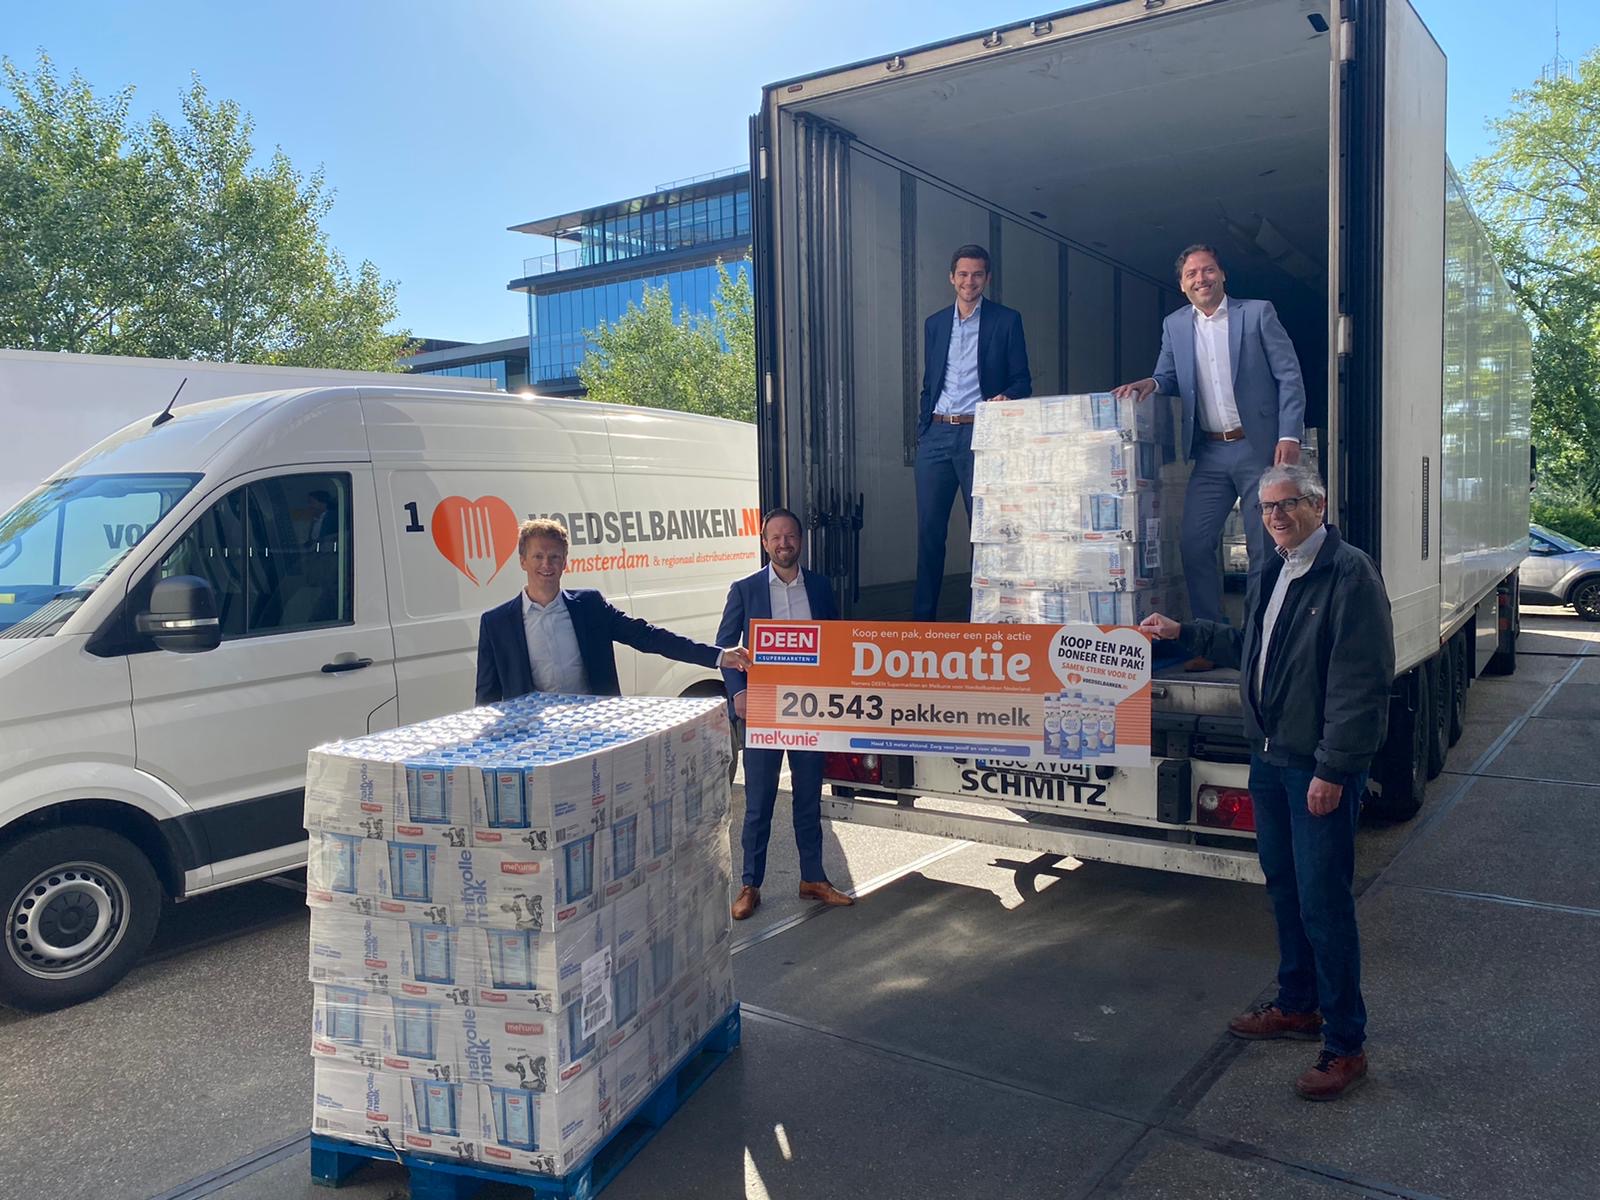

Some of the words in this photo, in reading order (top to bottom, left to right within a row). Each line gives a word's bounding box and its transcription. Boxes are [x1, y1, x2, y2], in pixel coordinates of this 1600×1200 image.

[403, 501, 425, 533] 1
[528, 508, 760, 546] EDSELBANKEN.N
[662, 553, 695, 568] regionaal
[696, 551, 756, 564] distributiecentrum
[760, 631, 814, 648] DEEN
[852, 628, 878, 640] Koop
[901, 628, 922, 640] pak,
[925, 629, 960, 639] doneer
[963, 632, 982, 640] een
[985, 631, 1004, 642] pak
[1007, 631, 1032, 641] actie
[1060, 635, 1092, 650] KOOP
[1095, 641, 1116, 654] EEN
[1119, 644, 1145, 660] PAK,
[852, 641, 1031, 682] Donatie
[1058, 648, 1097, 663] DONEER
[1100, 654, 1118, 667] EEN
[1121, 658, 1145, 670] PAK!
[1061, 662, 1084, 672] SAMEN
[1086, 666, 1106, 675] STERK
[1107, 669, 1127, 679] VOOR
[782, 691, 883, 720] 20.543
[891, 703, 968, 726] pakken
[977, 707, 1031, 727] melk
[750, 730, 818, 746] melkunie
[961, 769, 1106, 807] SCHMITZ
[462, 1009, 480, 1081] halfvolle
[476, 1038, 493, 1082] melk
